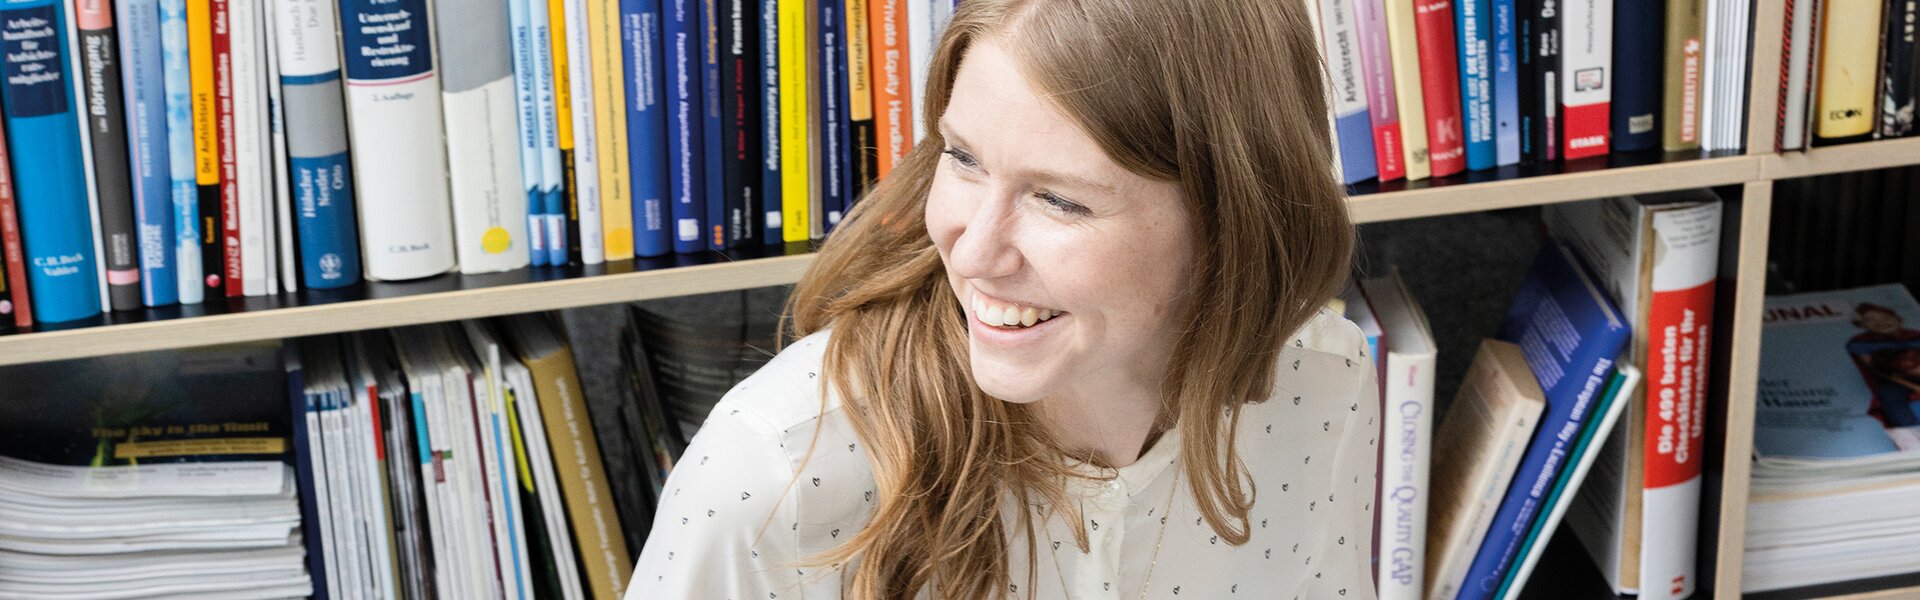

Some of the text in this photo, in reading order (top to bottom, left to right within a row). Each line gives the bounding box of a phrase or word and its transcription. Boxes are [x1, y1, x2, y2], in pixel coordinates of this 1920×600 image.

[2, 27, 55, 40] handbuch
[7, 18, 48, 29] Arbeits-
[289, 5, 305, 61] Handbuch
[358, 9, 412, 23] Unterneh-
[361, 19, 411, 34] menskauf
[883, 0, 897, 46] Private
[21, 41, 39, 50] für
[361, 44, 416, 56] Restruktu-
[377, 33, 399, 45] und
[732, 19, 742, 54] Firmen
[1464, 17, 1477, 56] BESTEN
[7, 50, 57, 62] Aufsichts-
[371, 55, 409, 67] rierung
[517, 25, 532, 91] ACQUISITIONS
[537, 25, 551, 91] ACQUISITIONS
[676, 33, 688, 99] Praxishandbuch
[884, 50, 900, 95] Equity
[1337, 30, 1357, 102] Arbeitsrecht
[1466, 57, 1477, 75] DIE
[8, 72, 60, 85] mitglieder
[86, 35, 107, 116] Börsengang
[767, 68, 777, 85] der
[1477, 40, 1491, 141] FINDEN UND HALTEN
[382, 92, 415, 101] Auflage
[1829, 107, 1863, 121] ECON
[199, 93, 211, 173] Der Aufsichtsrat
[524, 105, 535, 148] MERGERS
[543, 105, 554, 148] MERGERS
[767, 87, 779, 171] Kanzleinachfolge
[1570, 135, 1605, 149] STARK
[224, 163, 235, 180] und
[43, 266, 79, 276] Vahlen
[1593, 357, 1612, 376] The
[1692, 324, 1708, 438] Unternehmen
[1570, 374, 1602, 421] European
[1657, 326, 1677, 454] Die 499 besten
[1674, 308, 1695, 464] Checklisten für Ihr
[1400, 401, 1422, 462] CLOSING
[1557, 421, 1579, 442] Way
[1530, 448, 1565, 497] Excellence
[1390, 485, 1417, 543] QUALITY
[1391, 547, 1413, 585] GAP
